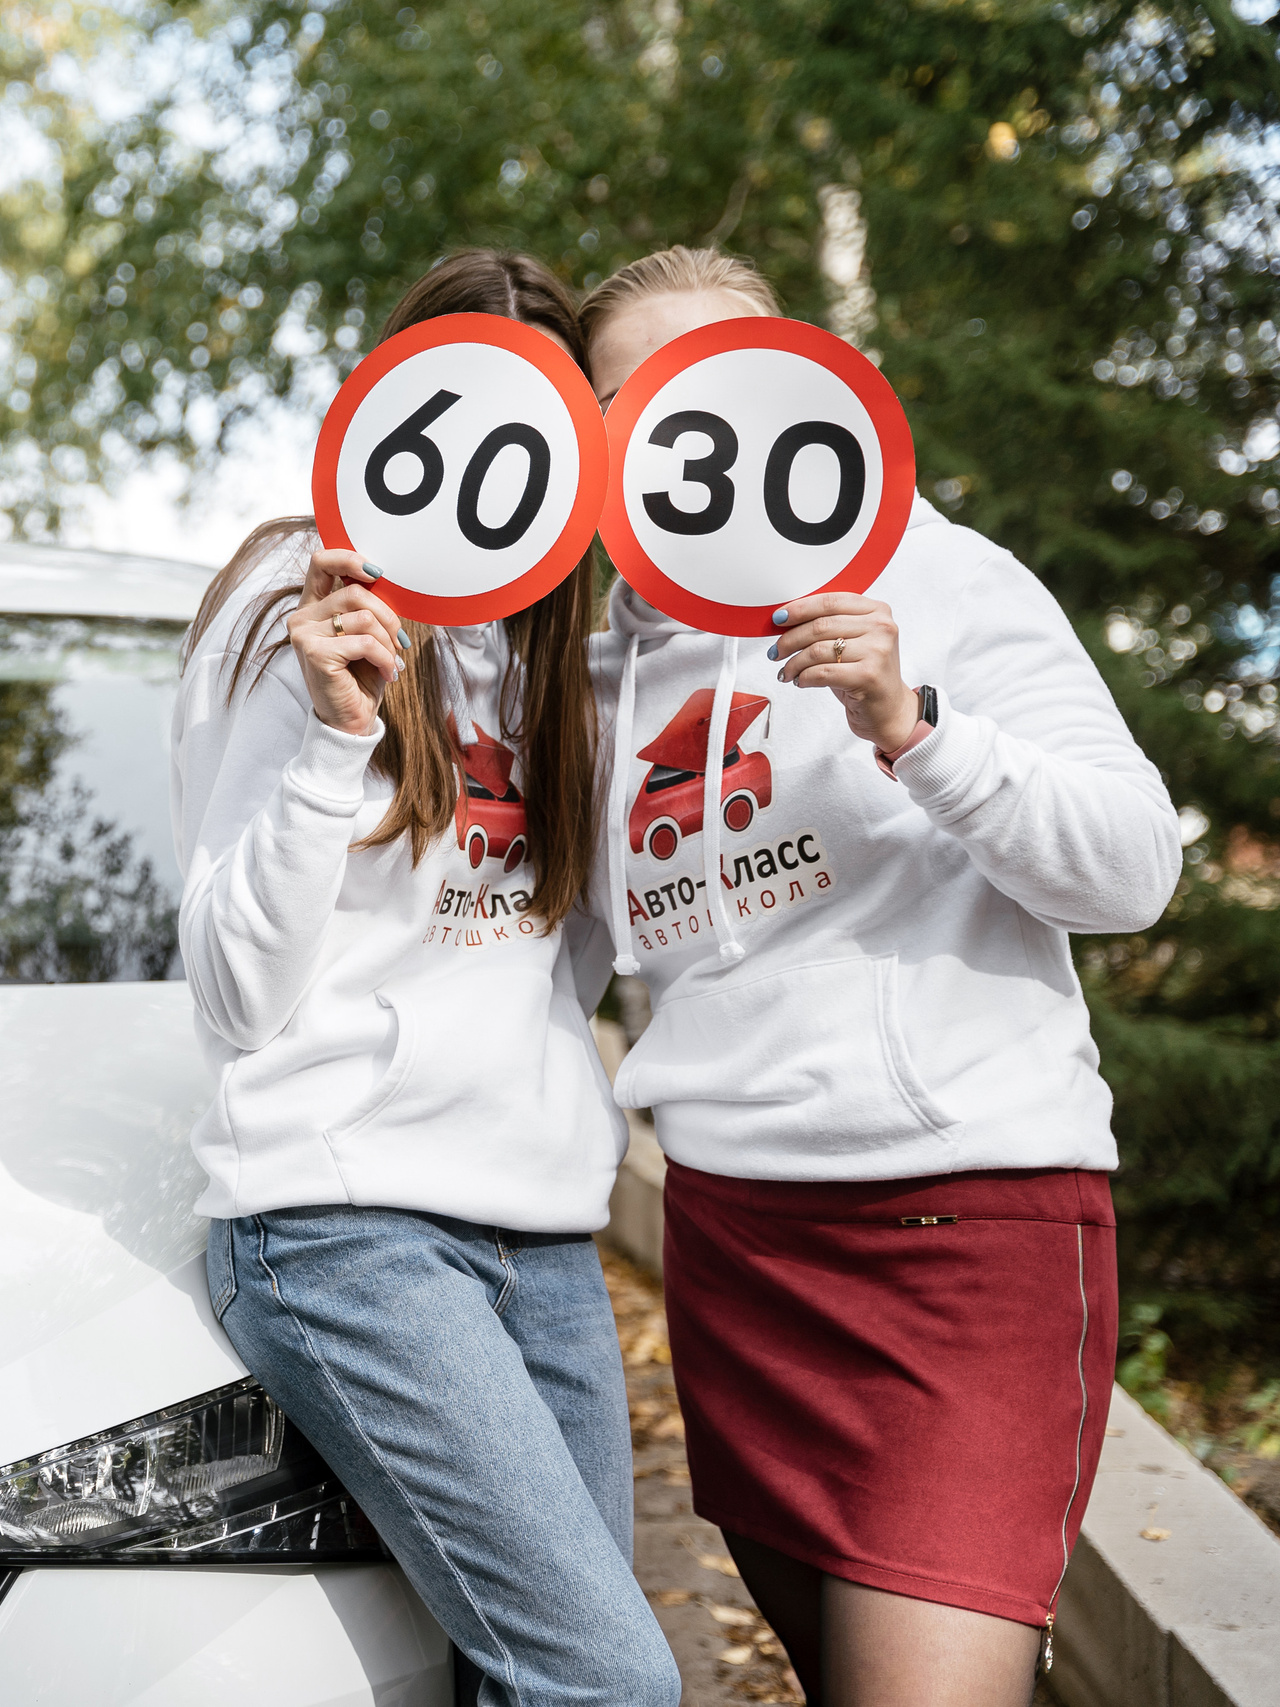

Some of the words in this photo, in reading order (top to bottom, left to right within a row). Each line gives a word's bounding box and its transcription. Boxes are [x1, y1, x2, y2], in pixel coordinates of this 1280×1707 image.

[364, 388, 551, 551] 60
[642, 410, 866, 546] 30
[422, 920, 558, 947] автошко
[432, 879, 533, 919] Авто-Кла
[638, 871, 831, 950] автокола
